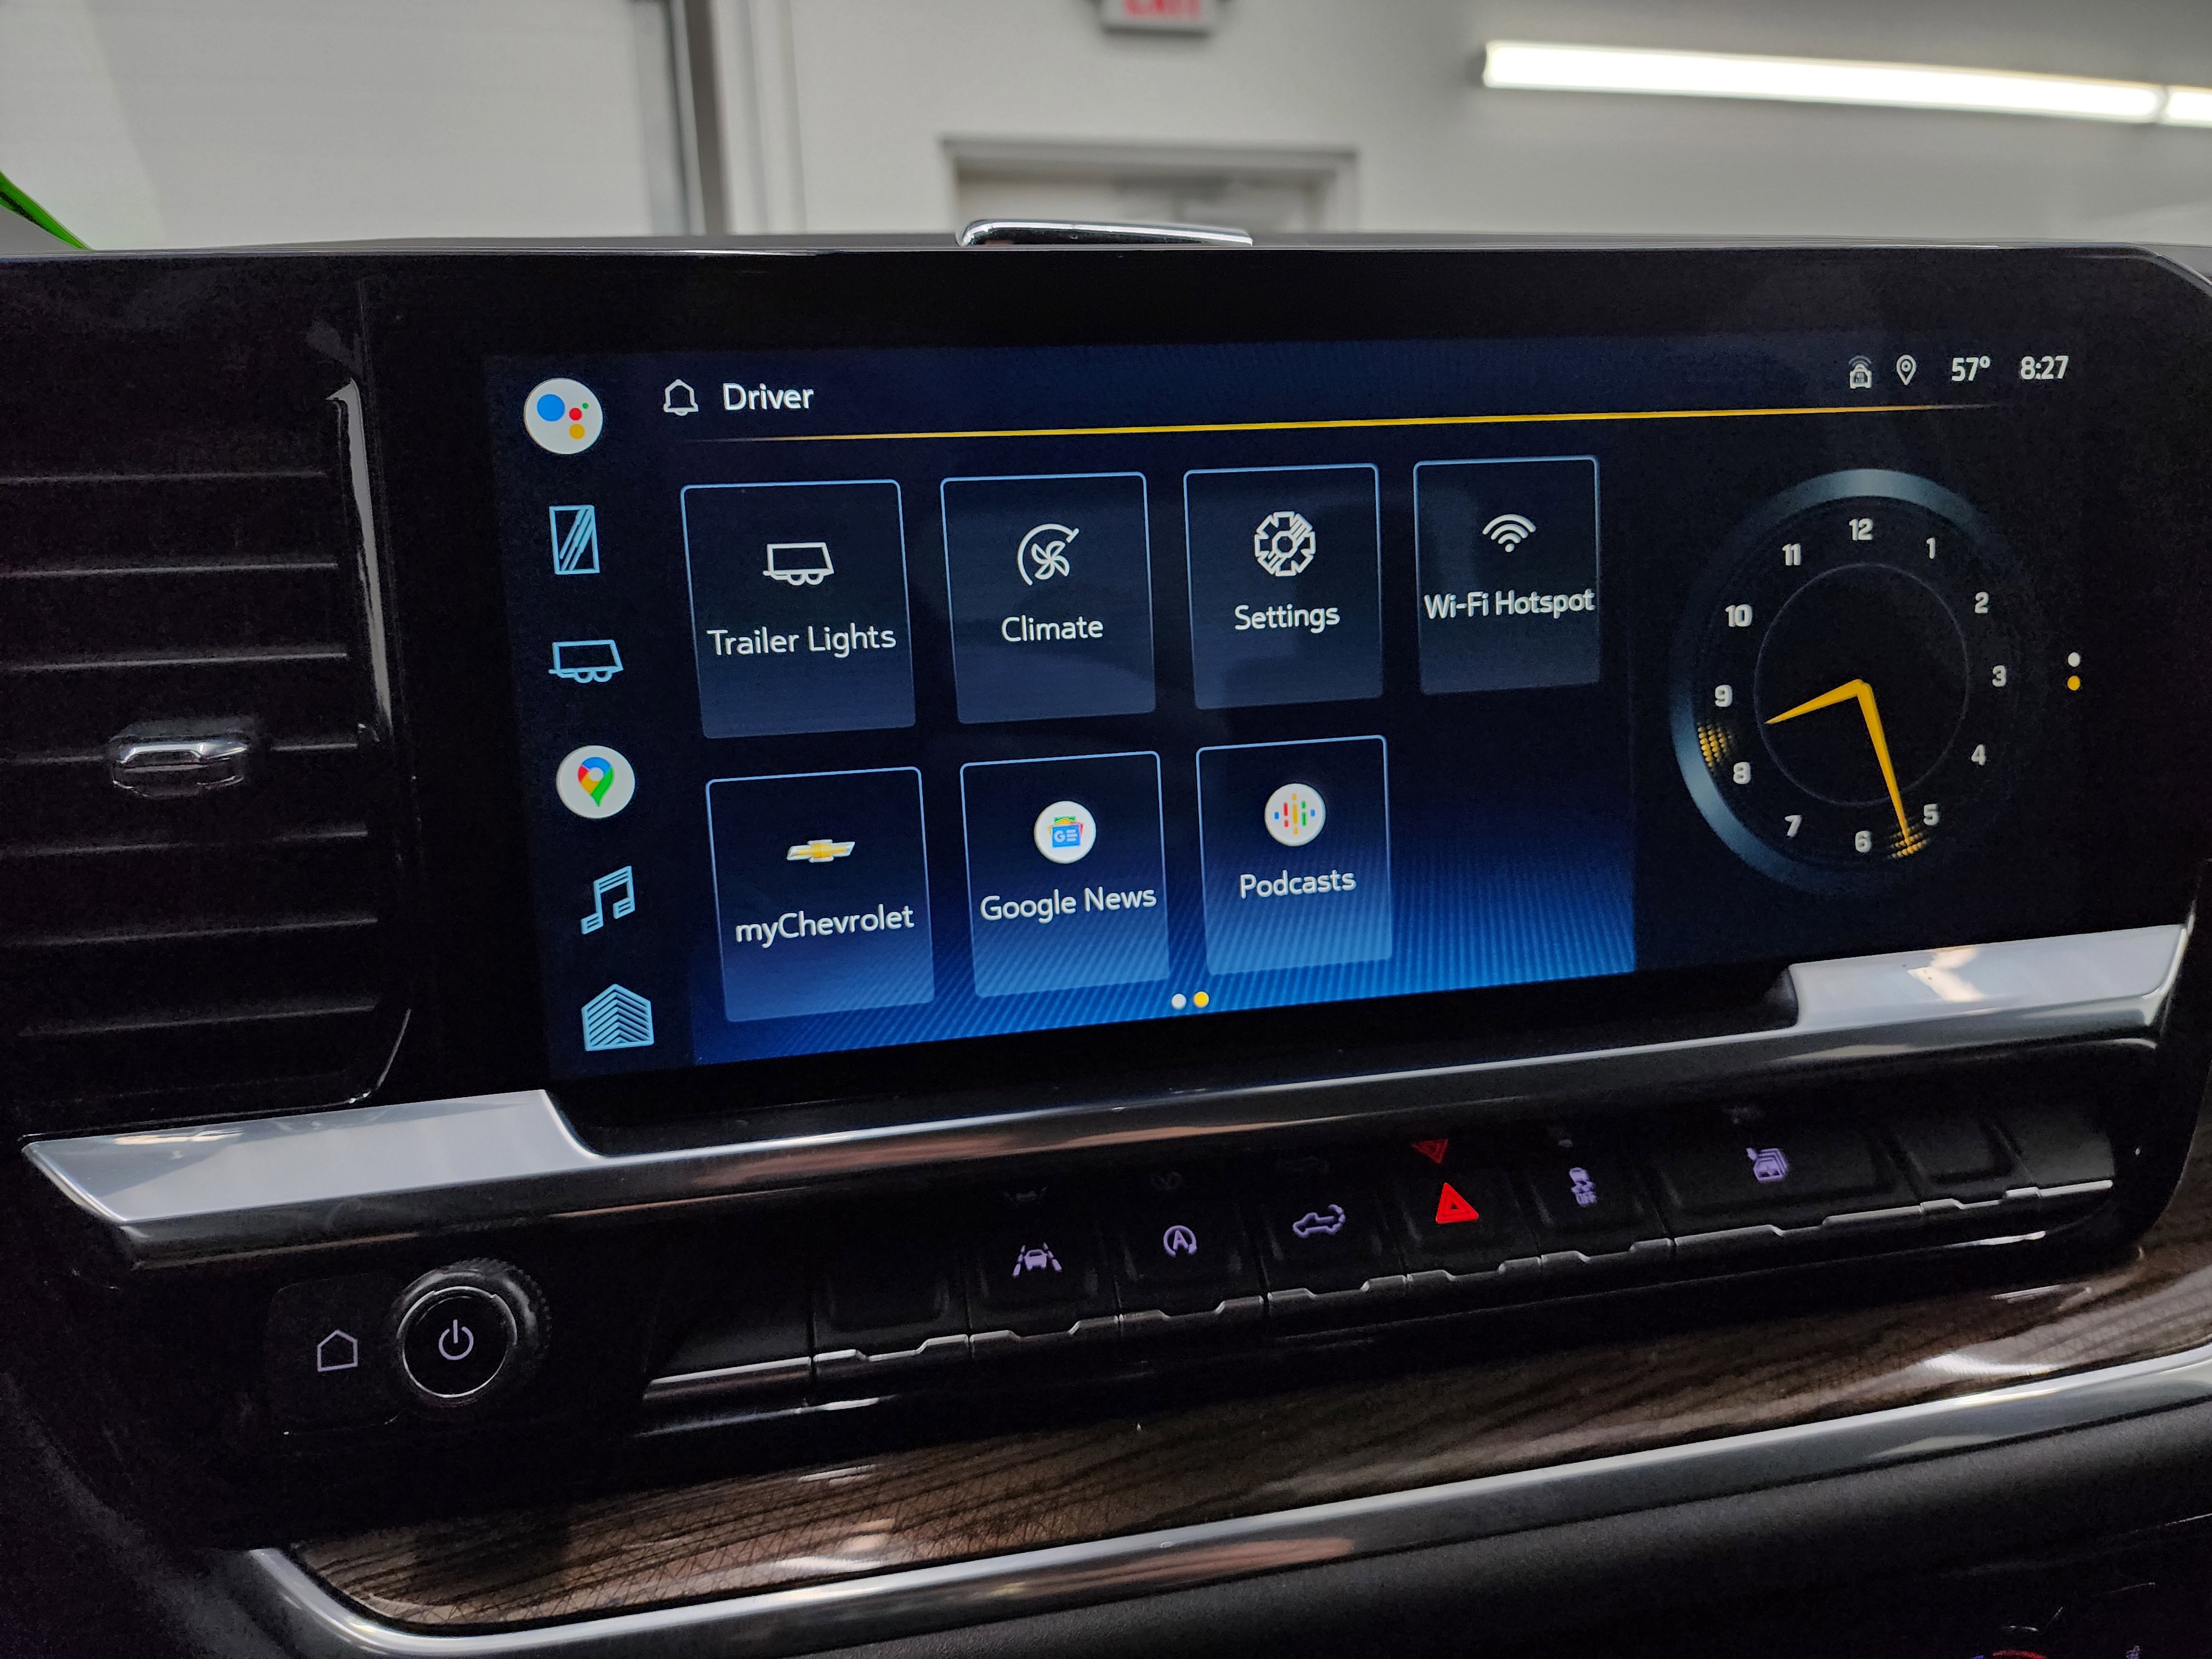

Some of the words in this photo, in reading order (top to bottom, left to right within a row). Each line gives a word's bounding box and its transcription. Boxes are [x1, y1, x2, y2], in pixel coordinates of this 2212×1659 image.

[1951, 354, 1991, 382] 57°
[2020, 354, 2069, 380] 8:27
[722, 382, 815, 411] Driver
[1848, 518, 1874, 541] 12
[1781, 542, 1802, 567] 11
[1926, 536, 1936, 560] 1
[1423, 591, 1489, 620] Wi-Fi
[1495, 588, 1595, 619] Hotspot
[1974, 591, 1989, 614] 2
[1234, 603, 1340, 634] Settings
[1724, 603, 1753, 628] 10
[706, 625, 800, 656] Trailer
[807, 622, 897, 659] Lights
[1001, 614, 1104, 643] Climate
[1991, 664, 2007, 687] 3
[1714, 684, 1733, 708] 9
[1970, 743, 1986, 766] 4
[1733, 761, 1751, 785] 8
[1784, 814, 1802, 838] 7
[1923, 803, 1939, 826] 5
[1854, 830, 1871, 853] 6
[1239, 869, 1357, 900] Podcasts
[979, 888, 1077, 924] Google
[1084, 885, 1157, 912] News
[735, 903, 915, 949] myChevrolet
